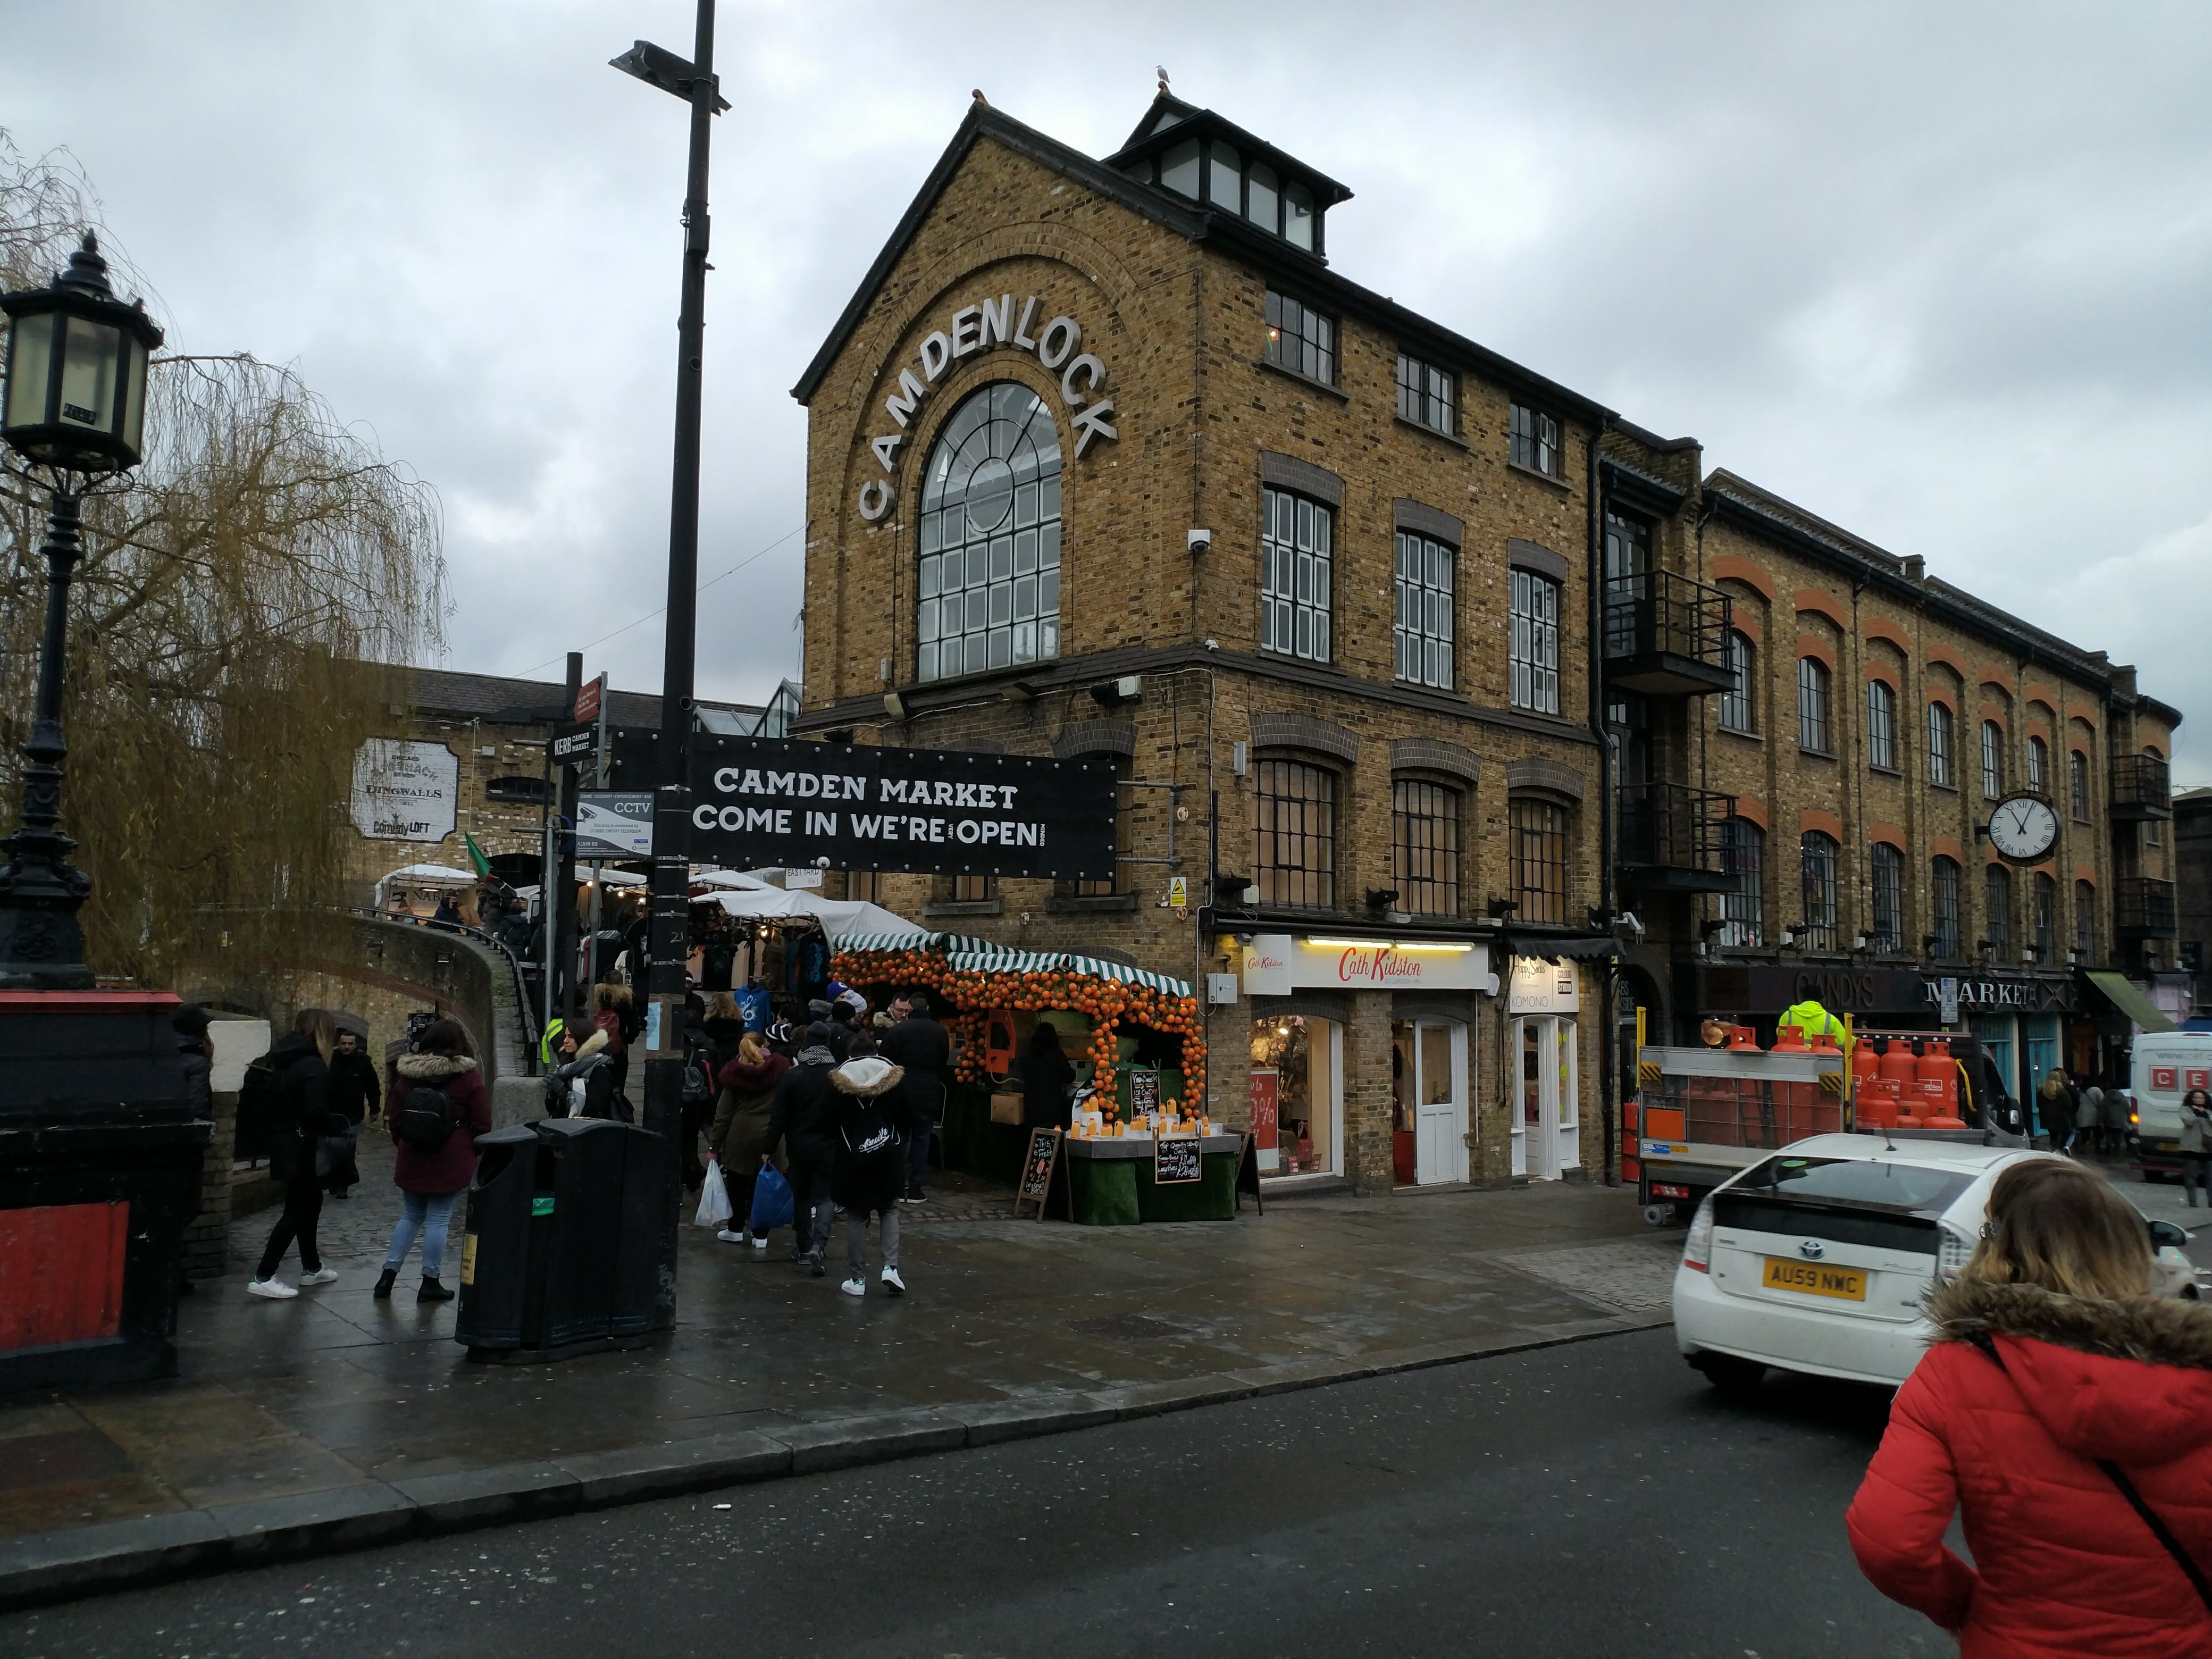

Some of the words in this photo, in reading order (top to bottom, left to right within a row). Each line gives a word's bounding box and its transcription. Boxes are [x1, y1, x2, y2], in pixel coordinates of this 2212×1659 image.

[572, 732, 590, 742] CAMDEN
[555, 737, 572, 756] KERB
[572, 742, 590, 752] MARKET
[366, 784, 442, 799] DINGWALLS
[714, 767, 867, 801] CAMDEN
[879, 778, 1018, 810] MARKET
[614, 802, 651, 813] CCTV
[409, 822, 430, 833] LOFT
[692, 804, 792, 834] COME
[806, 811, 837, 836] IN
[851, 814, 945, 843] WE'RE
[957, 819, 1037, 847] OPEN
[670, 931, 684, 943] 21
[1248, 957, 1260, 969] Cath
[1261, 957, 1283, 969] Kidston
[1339, 947, 1370, 982] Cath
[1370, 948, 1422, 982] Kidston
[1514, 958, 1530, 979] Happy
[1530, 958, 1545, 975] Socks
[1558, 970, 1571, 979] COLOUR
[1558, 983, 1571, 993] STUDIO
[1924, 982, 2027, 1004] MARKET
[1511, 995, 1548, 1008] KOMONO
[1036, 1137, 1051, 1149] This
[1038, 1146, 1053, 1159] Fresh
[1771, 1266, 1817, 1287] AU59
